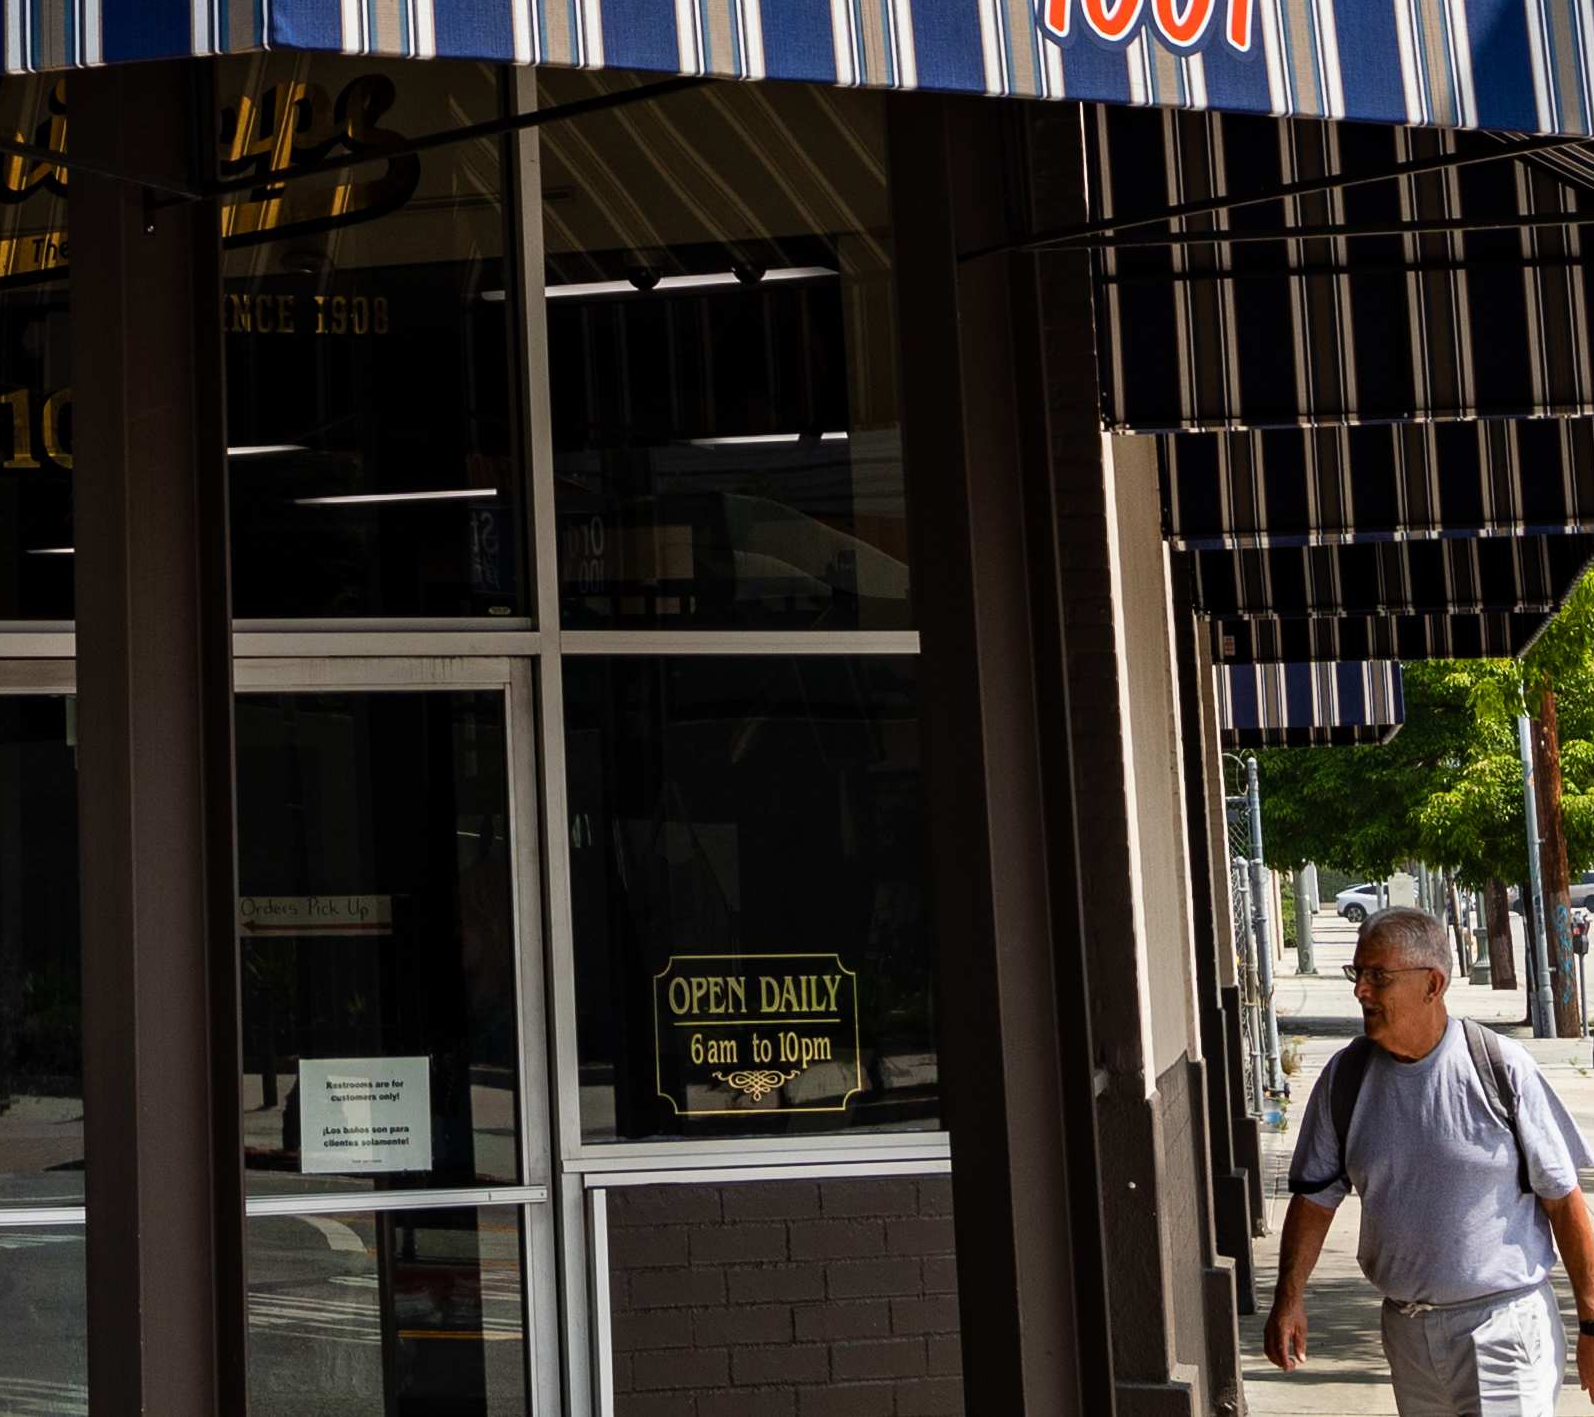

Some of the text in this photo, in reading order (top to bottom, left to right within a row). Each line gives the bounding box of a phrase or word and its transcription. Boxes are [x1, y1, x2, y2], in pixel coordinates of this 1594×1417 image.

[222, 293, 390, 336] NCE 1908
[347, 897, 370, 920] Up
[668, 974, 842, 1015] OPEN DAILY
[752, 1033, 772, 1063] to
[778, 1030, 832, 1068] 10pm
[325, 1079, 404, 1089] Restrooms are for
[330, 1092, 400, 1102] customers only!
[371, 1126, 388, 1134] son
[389, 1125, 410, 1135] para
[323, 1138, 359, 1148] clientes
